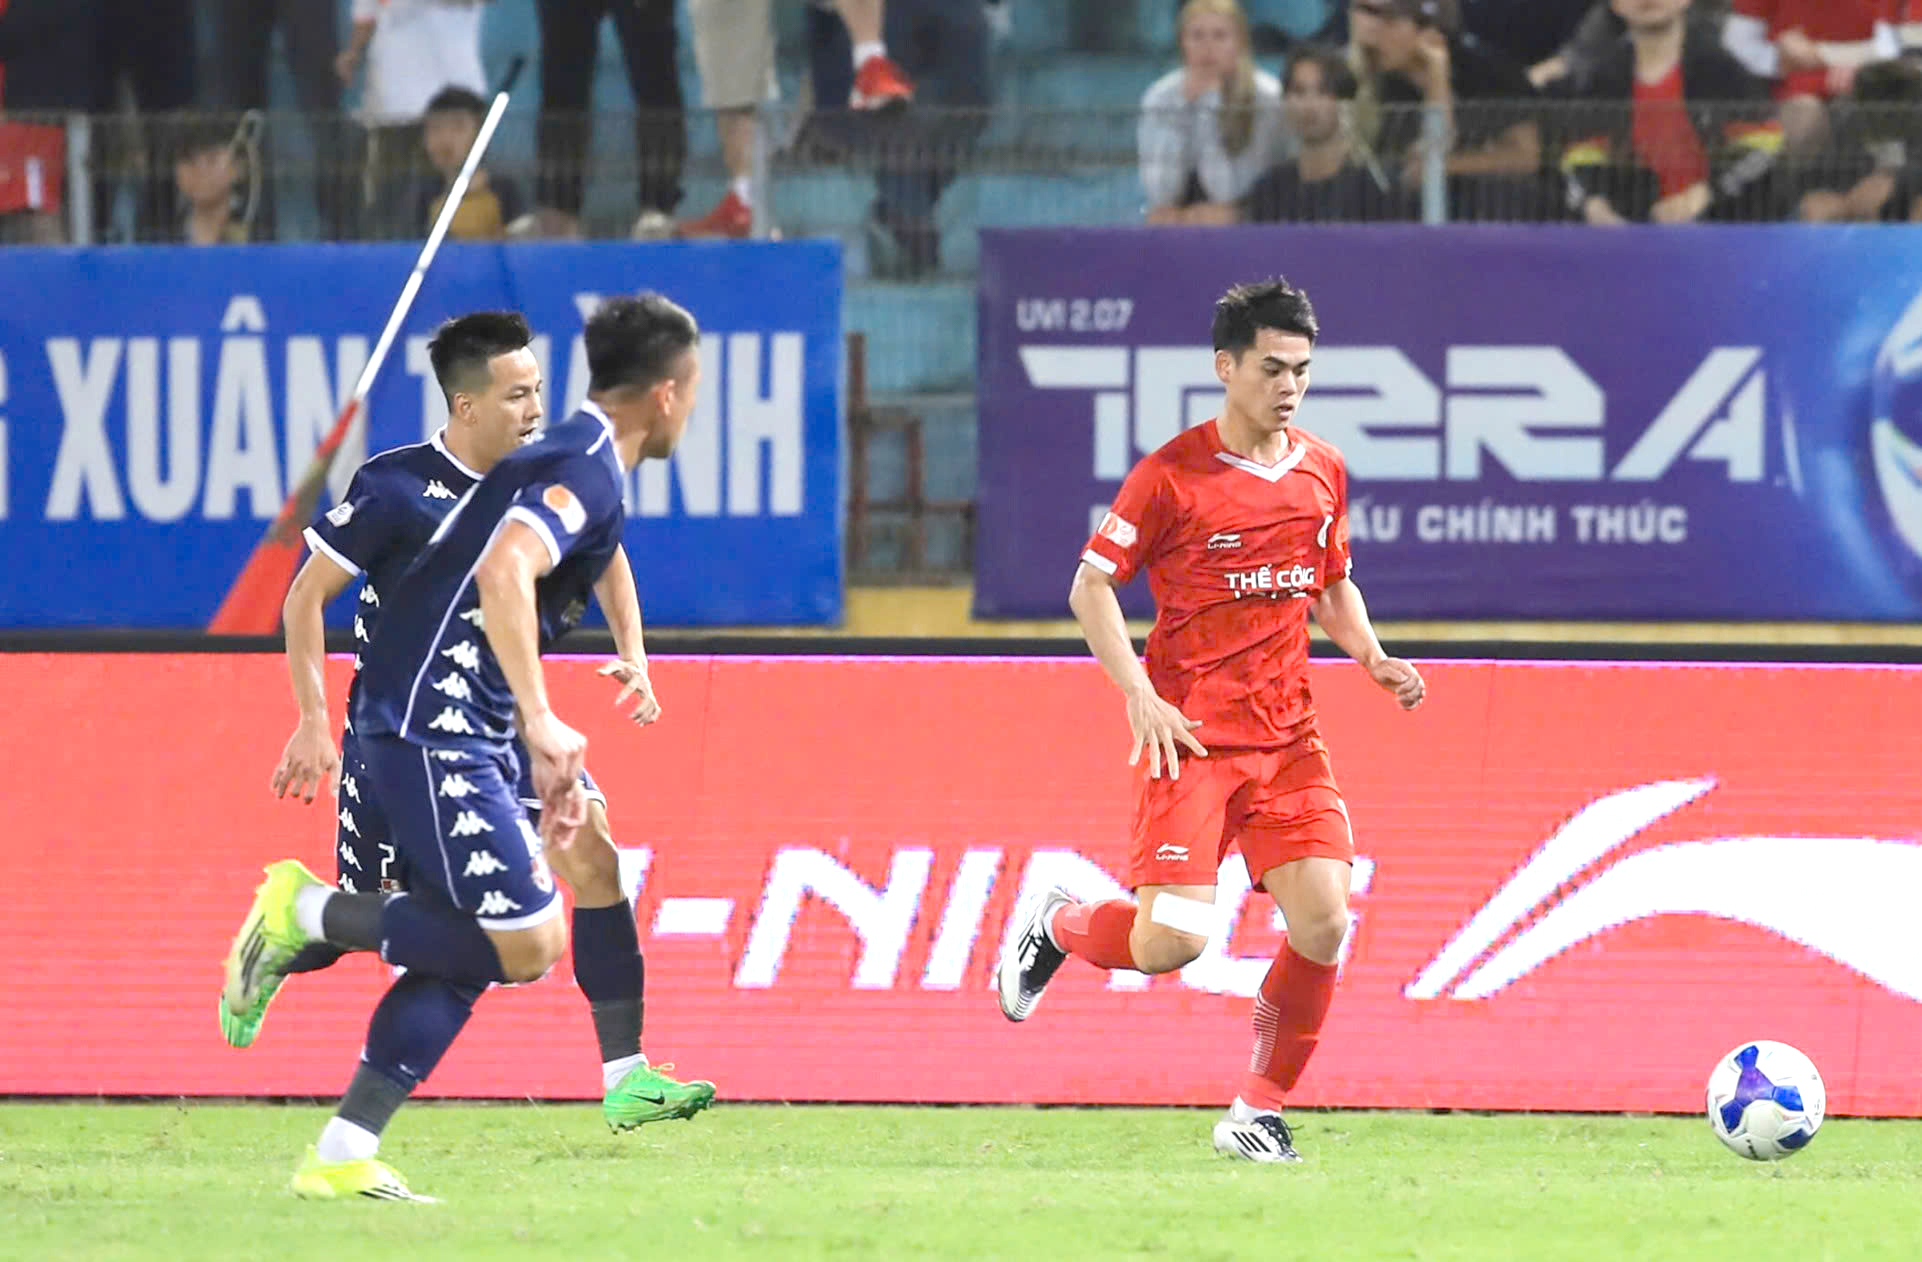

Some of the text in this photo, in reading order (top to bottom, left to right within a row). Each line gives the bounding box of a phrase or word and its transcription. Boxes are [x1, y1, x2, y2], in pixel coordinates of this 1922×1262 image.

[45, 295, 369, 521] XUÂN
[1348, 494, 1402, 543] ẤU
[1416, 498, 1557, 544] CHÍNH
[1224, 563, 1272, 589] THẾ
[575, 844, 1375, 998] -NIG
